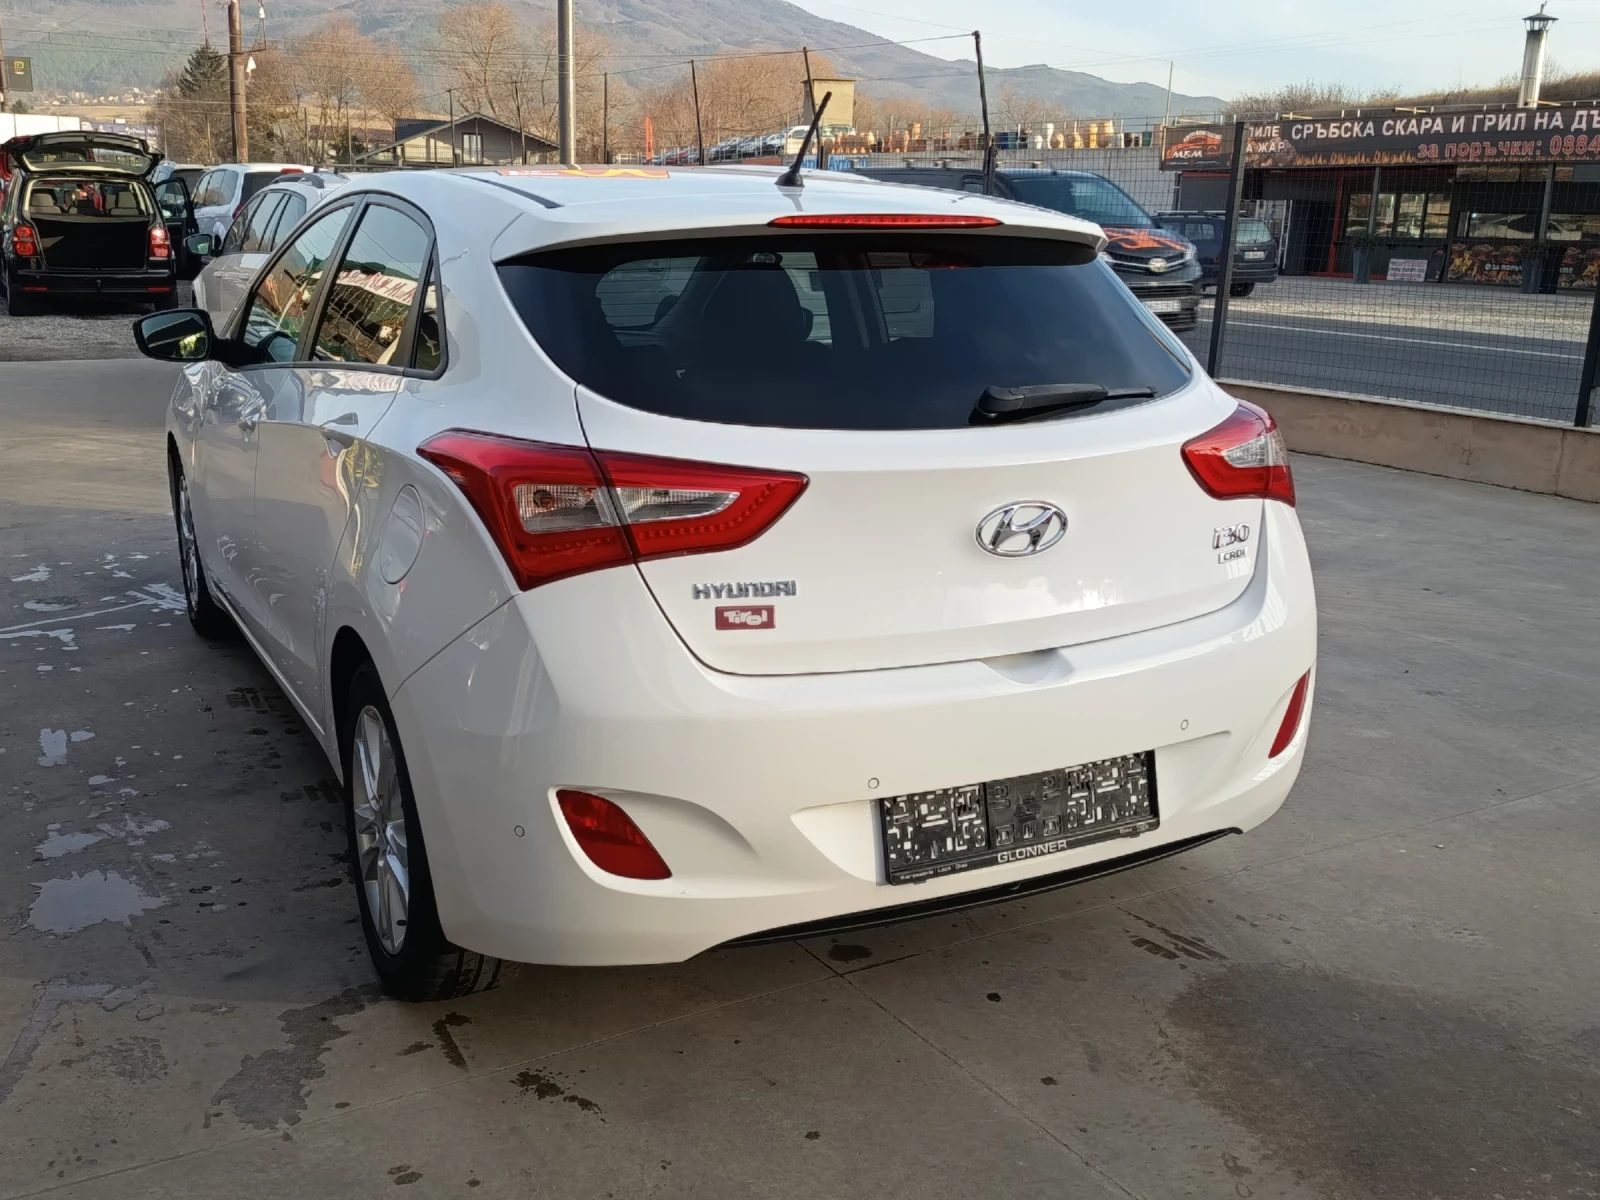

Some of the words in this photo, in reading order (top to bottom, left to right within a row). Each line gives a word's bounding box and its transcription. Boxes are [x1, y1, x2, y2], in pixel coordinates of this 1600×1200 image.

[1291, 120, 1375, 140] СРЪБСКА
[1382, 117, 1444, 136] СКАРА
[1451, 115, 1466, 134] И
[1471, 112, 1527, 133] ГРИЛ
[1534, 111, 1564, 131] НА
[1258, 141, 1285, 154] ЖАР
[1417, 143, 1439, 159] за
[1444, 139, 1542, 161] поръчки:
[1212, 522, 1250, 550] i30
[692, 580, 797, 600] HYUNDAI
[723, 609, 768, 625] Tirol
[997, 839, 1068, 864] GLONNER
